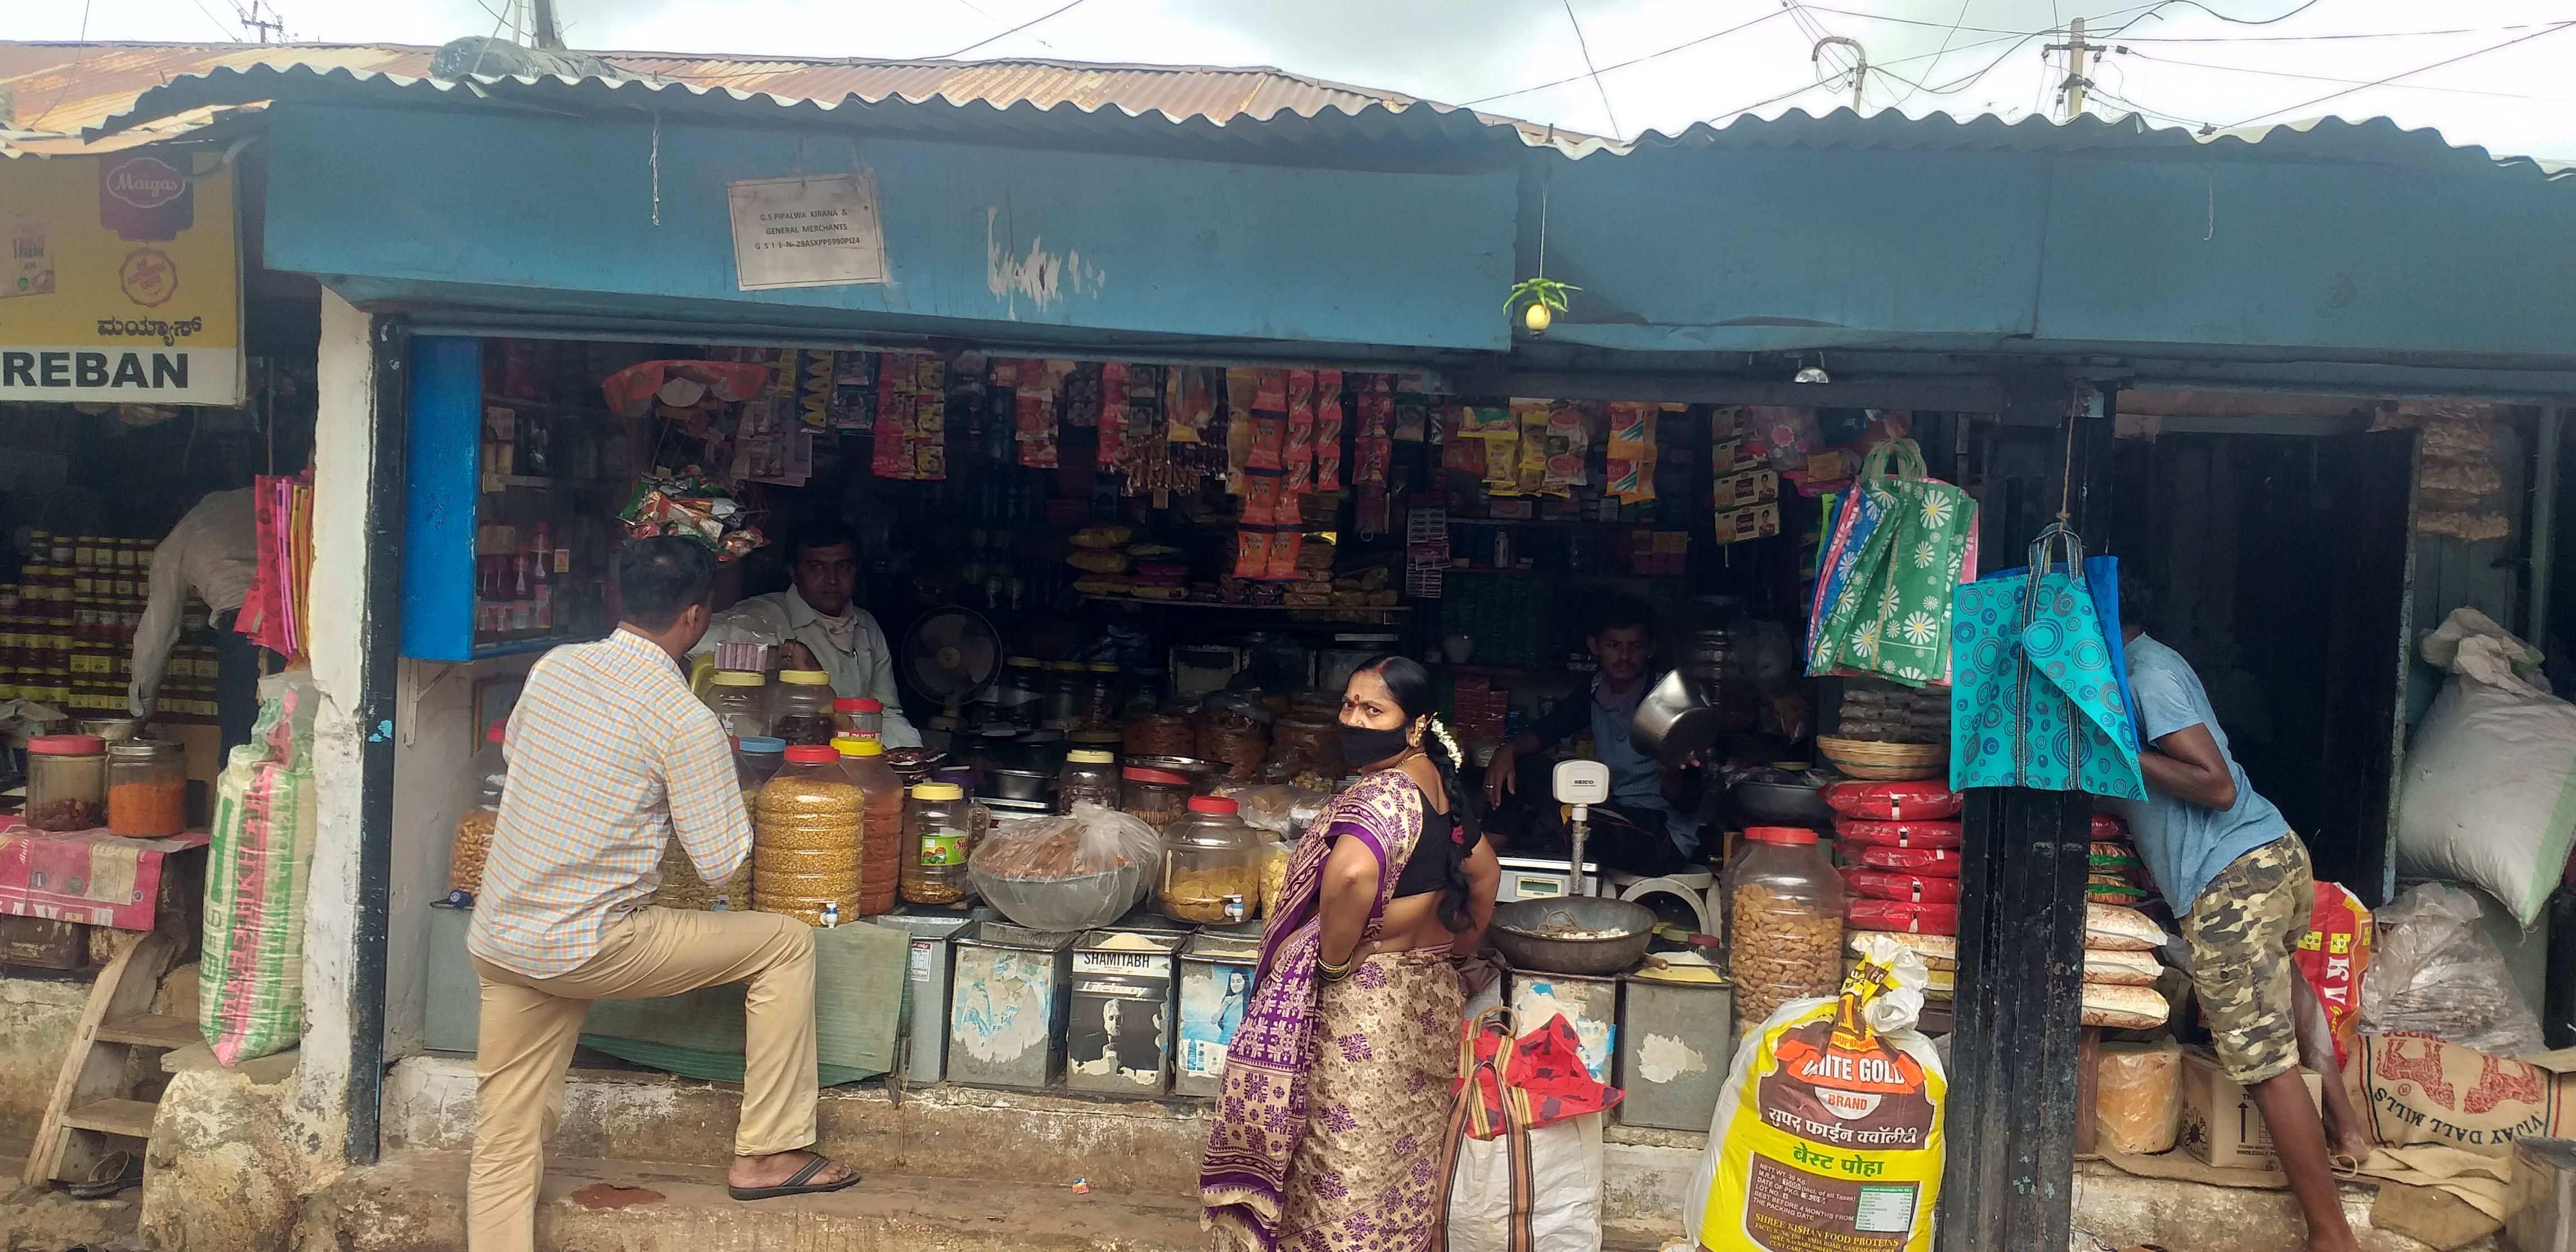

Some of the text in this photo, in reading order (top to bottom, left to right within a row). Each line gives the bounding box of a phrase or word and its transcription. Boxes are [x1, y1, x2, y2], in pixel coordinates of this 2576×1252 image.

[113, 173, 178, 197] Maiyas
[810, 210, 838, 218] KIRANA
[766, 223, 847, 235] GENERAL MERCHANTS
[2, 351, 189, 389] REBAN
[1083, 952, 1150, 969] SHAMITABH
[1858, 1057, 1906, 1084] GOLD
[1827, 1094, 1868, 1110] BRAND
[2374, 1087, 2544, 1145] VIJAY DALL MILLS
[1805, 1120, 1854, 1143] फाईन
[1759, 1163, 1775, 1174] NETT
[1775, 1168, 1787, 1178] WT.
[1793, 1141, 1884, 1177] बेस्ट पोहा
[1755, 1183, 1768, 1193] LOT
[1757, 1177, 1773, 1186] DATE
[1784, 1187, 1800, 1197] PKG.
[1836, 1194, 1856, 1202] Taxes)
[1753, 1197, 1815, 1221] THE PACKING DATE
[1754, 1190, 1770, 1201] BEST
[1772, 1196, 1799, 1210] BEFORE
[1805, 1207, 1834, 1220] MONTHS
[1755, 1213, 1899, 1247] SHREE KISHAN FOOD PROTEINS
